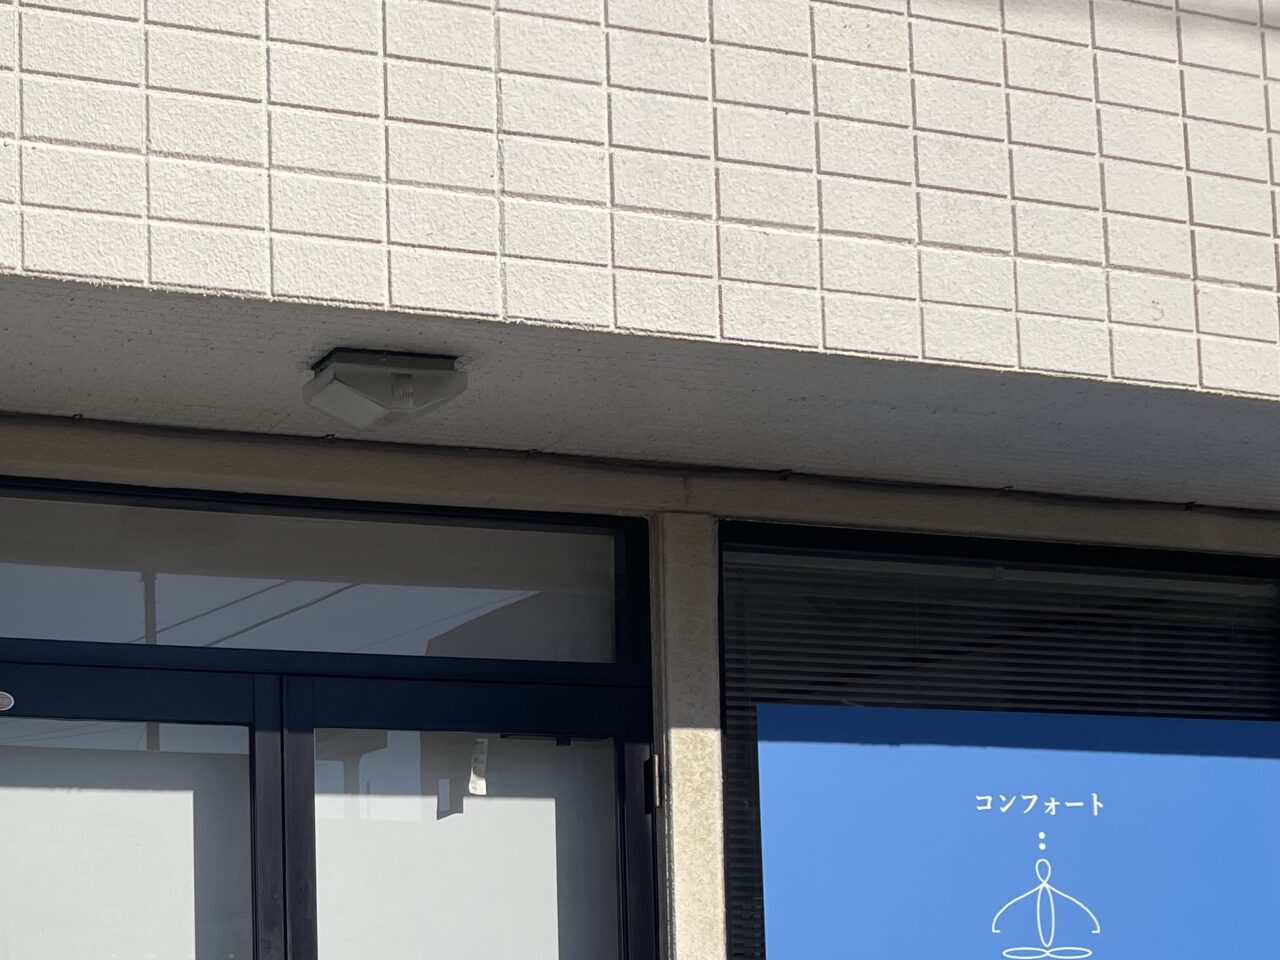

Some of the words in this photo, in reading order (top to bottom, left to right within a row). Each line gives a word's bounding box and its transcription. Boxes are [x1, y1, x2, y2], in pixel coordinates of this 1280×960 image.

[975, 793, 1104, 816] コンフォート
